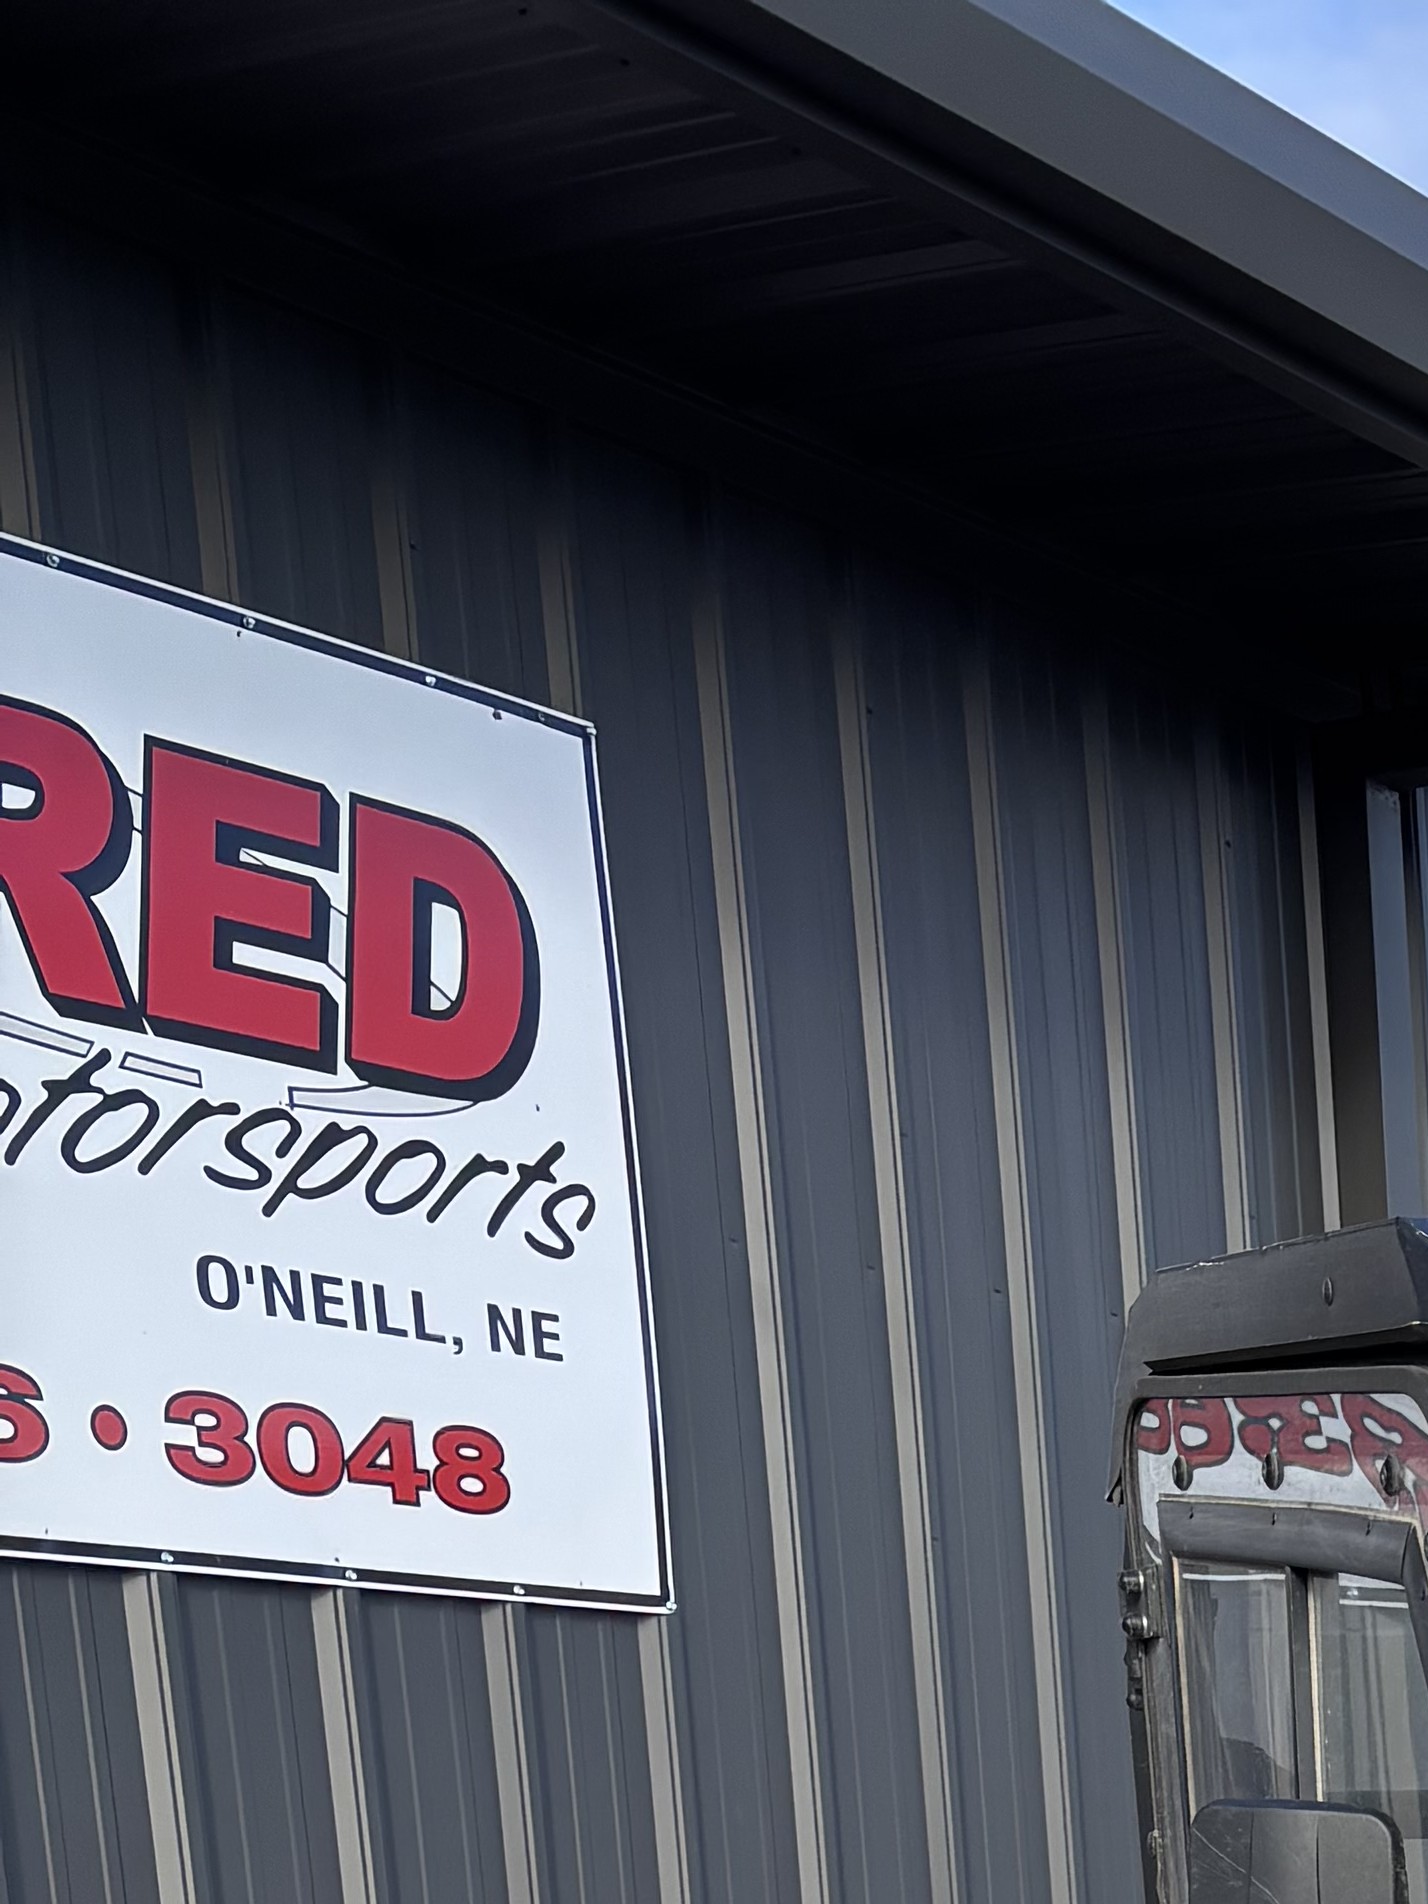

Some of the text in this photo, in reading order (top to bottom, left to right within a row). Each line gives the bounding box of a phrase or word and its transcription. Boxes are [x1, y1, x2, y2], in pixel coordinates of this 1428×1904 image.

[0, 694, 541, 1102] RED
[196, 1255, 564, 1362] O'NEILL, NE
[165, 1390, 511, 1515] 3048
